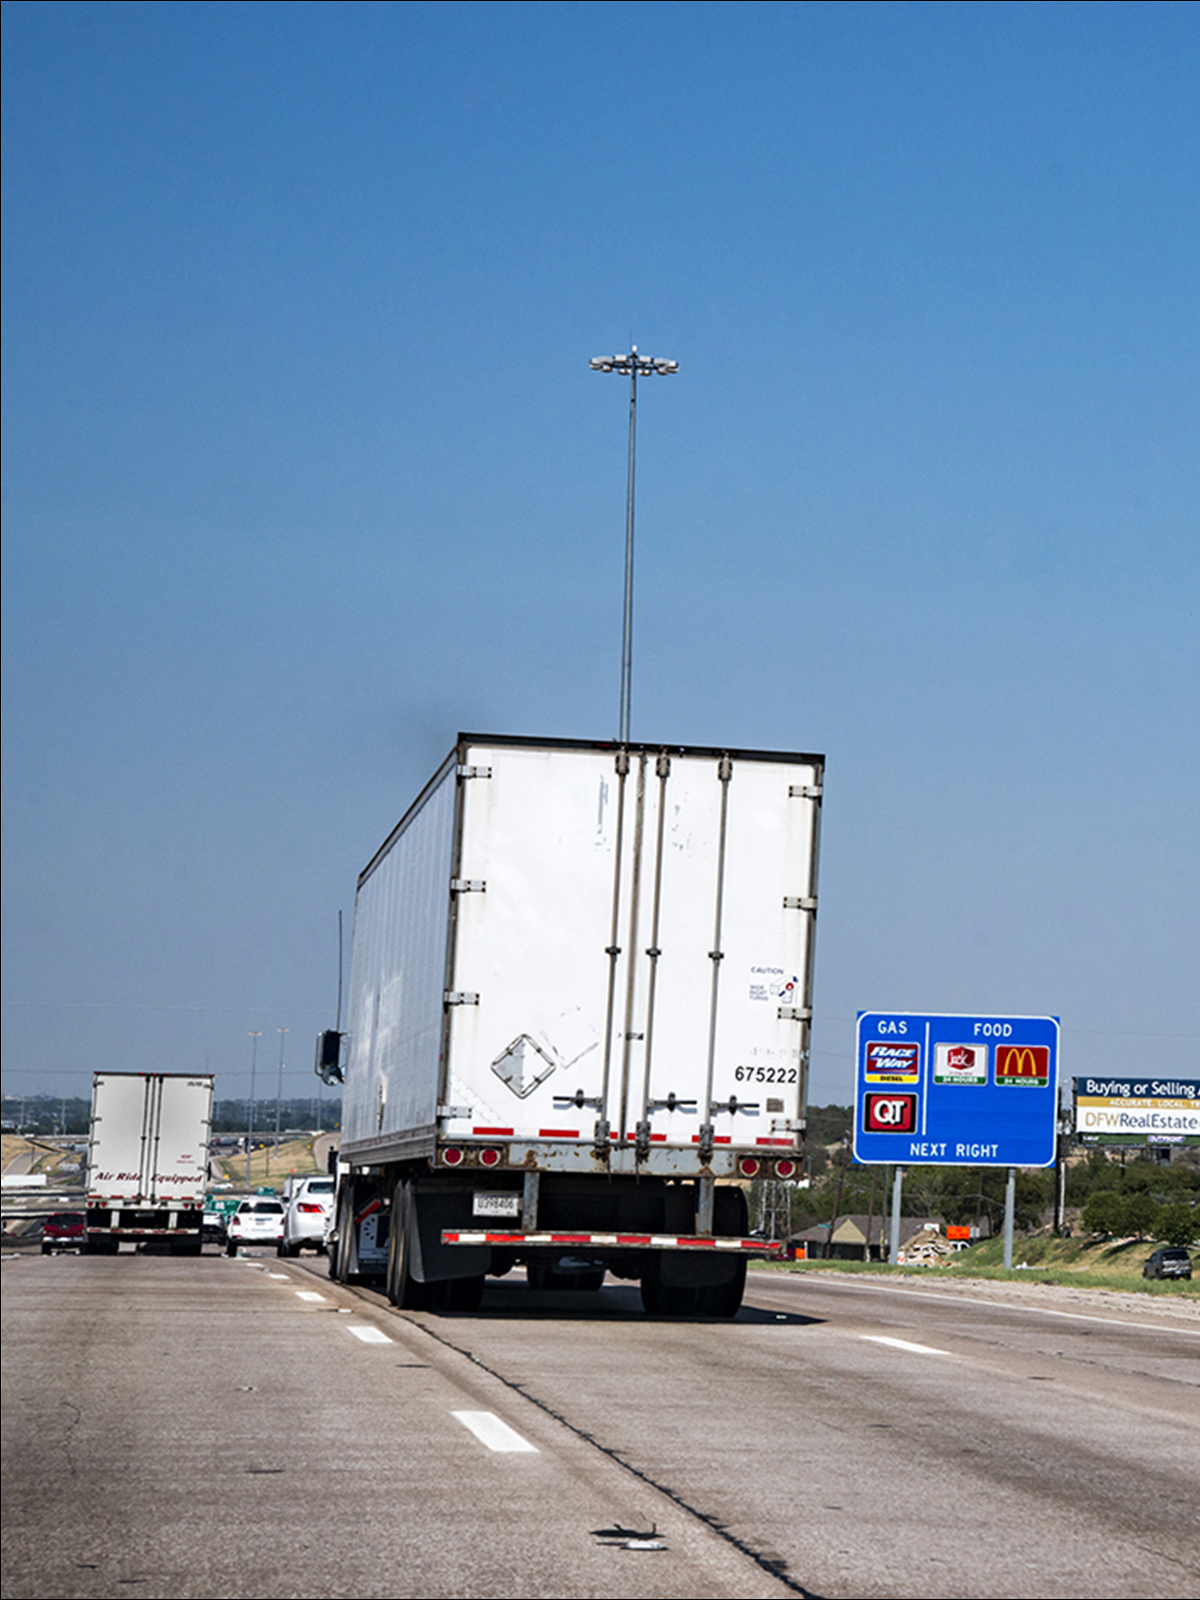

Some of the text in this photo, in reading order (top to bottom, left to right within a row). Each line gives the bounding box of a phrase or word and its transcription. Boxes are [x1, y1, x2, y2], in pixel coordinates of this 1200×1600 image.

[750, 966, 784, 975] CAUTION
[877, 1020, 908, 1035] GAS
[973, 1023, 1013, 1037] FOOD
[870, 1046, 916, 1058] RACE
[874, 1057, 914, 1069] WAY
[734, 1065, 798, 1083] 675222
[955, 1076, 979, 1084] HOURS
[1086, 1079, 1130, 1097] Buying
[1133, 1082, 1149, 1095] or
[1151, 1081, 1195, 1098] Selling
[1109, 1099, 1155, 1108] ACCURATE.
[1157, 1100, 1188, 1109] LOCAL.
[874, 1100, 906, 1125] QT
[910, 1143, 999, 1157] NEXT RIGHT
[95, 1172, 203, 1184] Air Ride Equipped
